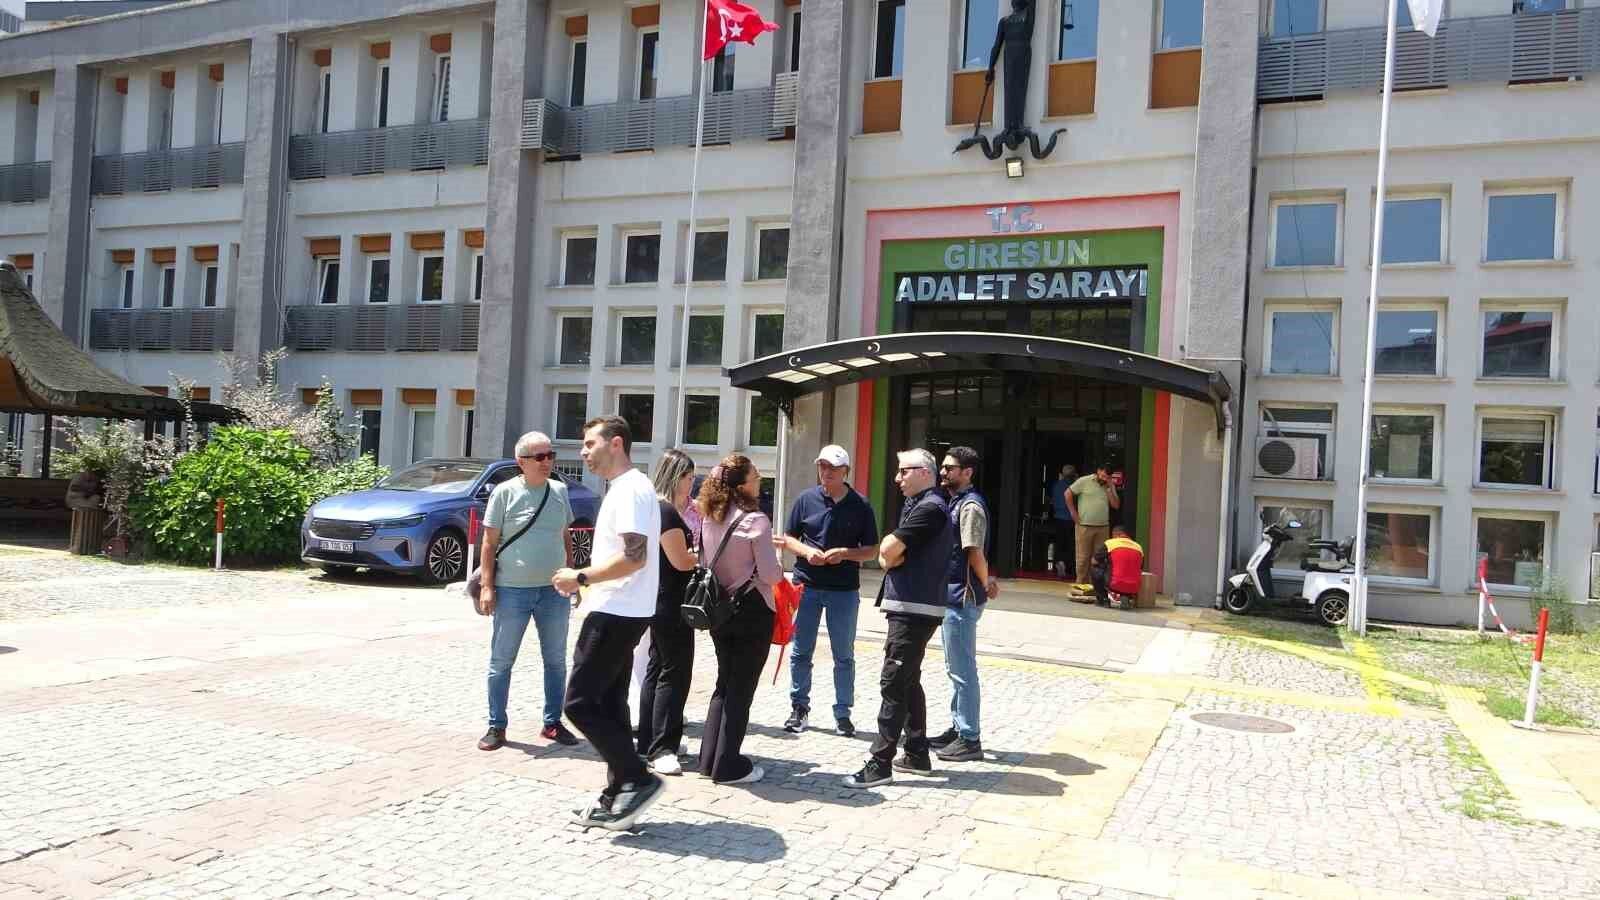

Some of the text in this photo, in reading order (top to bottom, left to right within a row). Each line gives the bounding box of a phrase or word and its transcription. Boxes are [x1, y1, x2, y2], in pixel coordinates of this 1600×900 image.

[985, 206, 1043, 232] T.C.
[945, 239, 1089, 270] GİRESUN
[896, 270, 1148, 302] ADALET SARAYI
